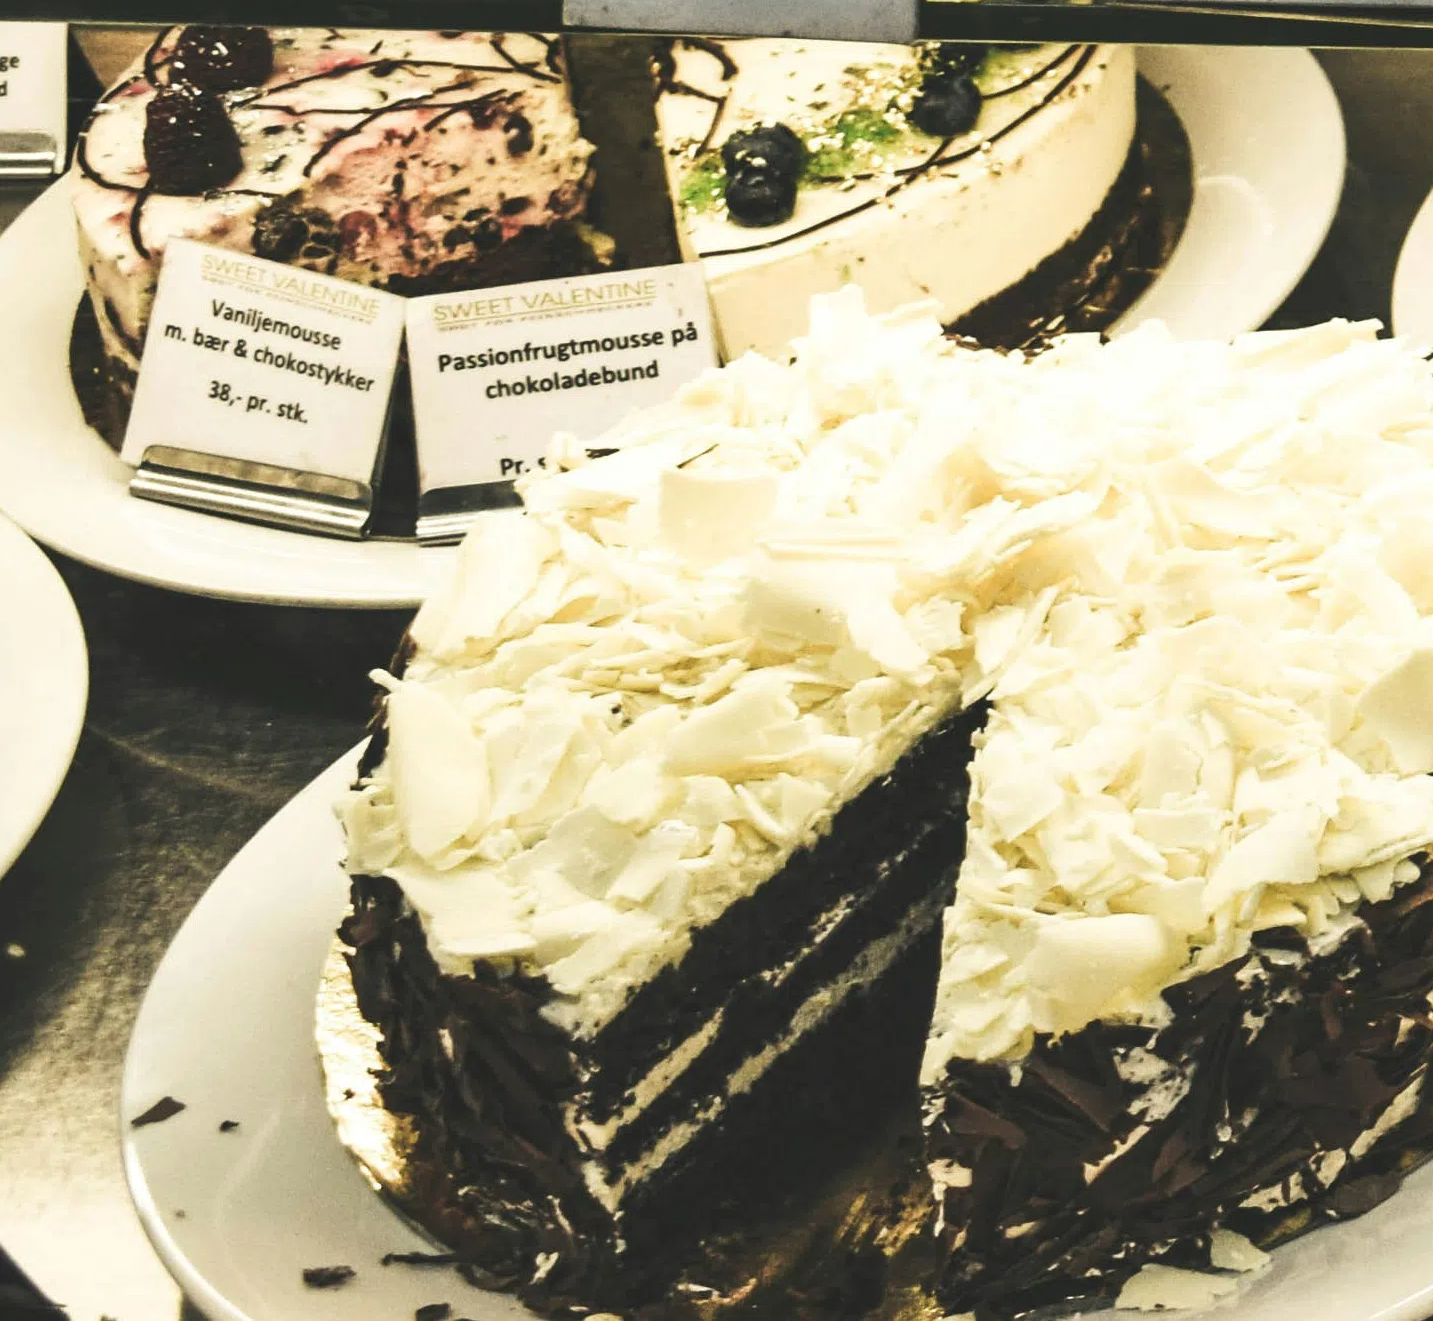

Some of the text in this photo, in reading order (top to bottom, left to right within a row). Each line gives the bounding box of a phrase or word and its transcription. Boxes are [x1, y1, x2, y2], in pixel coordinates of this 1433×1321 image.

[201, 254, 268, 286] SWEET
[271, 270, 379, 316] VALENTINE
[434, 296, 513, 322] SWEET
[519, 279, 656, 312] VALENTINE
[210, 299, 341, 350] Vaniljemousse
[438, 320, 699, 374] Passionfrugtmousse på
[164, 320, 375, 393] m. bær & chokostykker
[486, 360, 659, 400] chokoladebund
[208, 380, 308, 424] 38,- pr. stk.
[500, 458, 530, 476] Pr.
